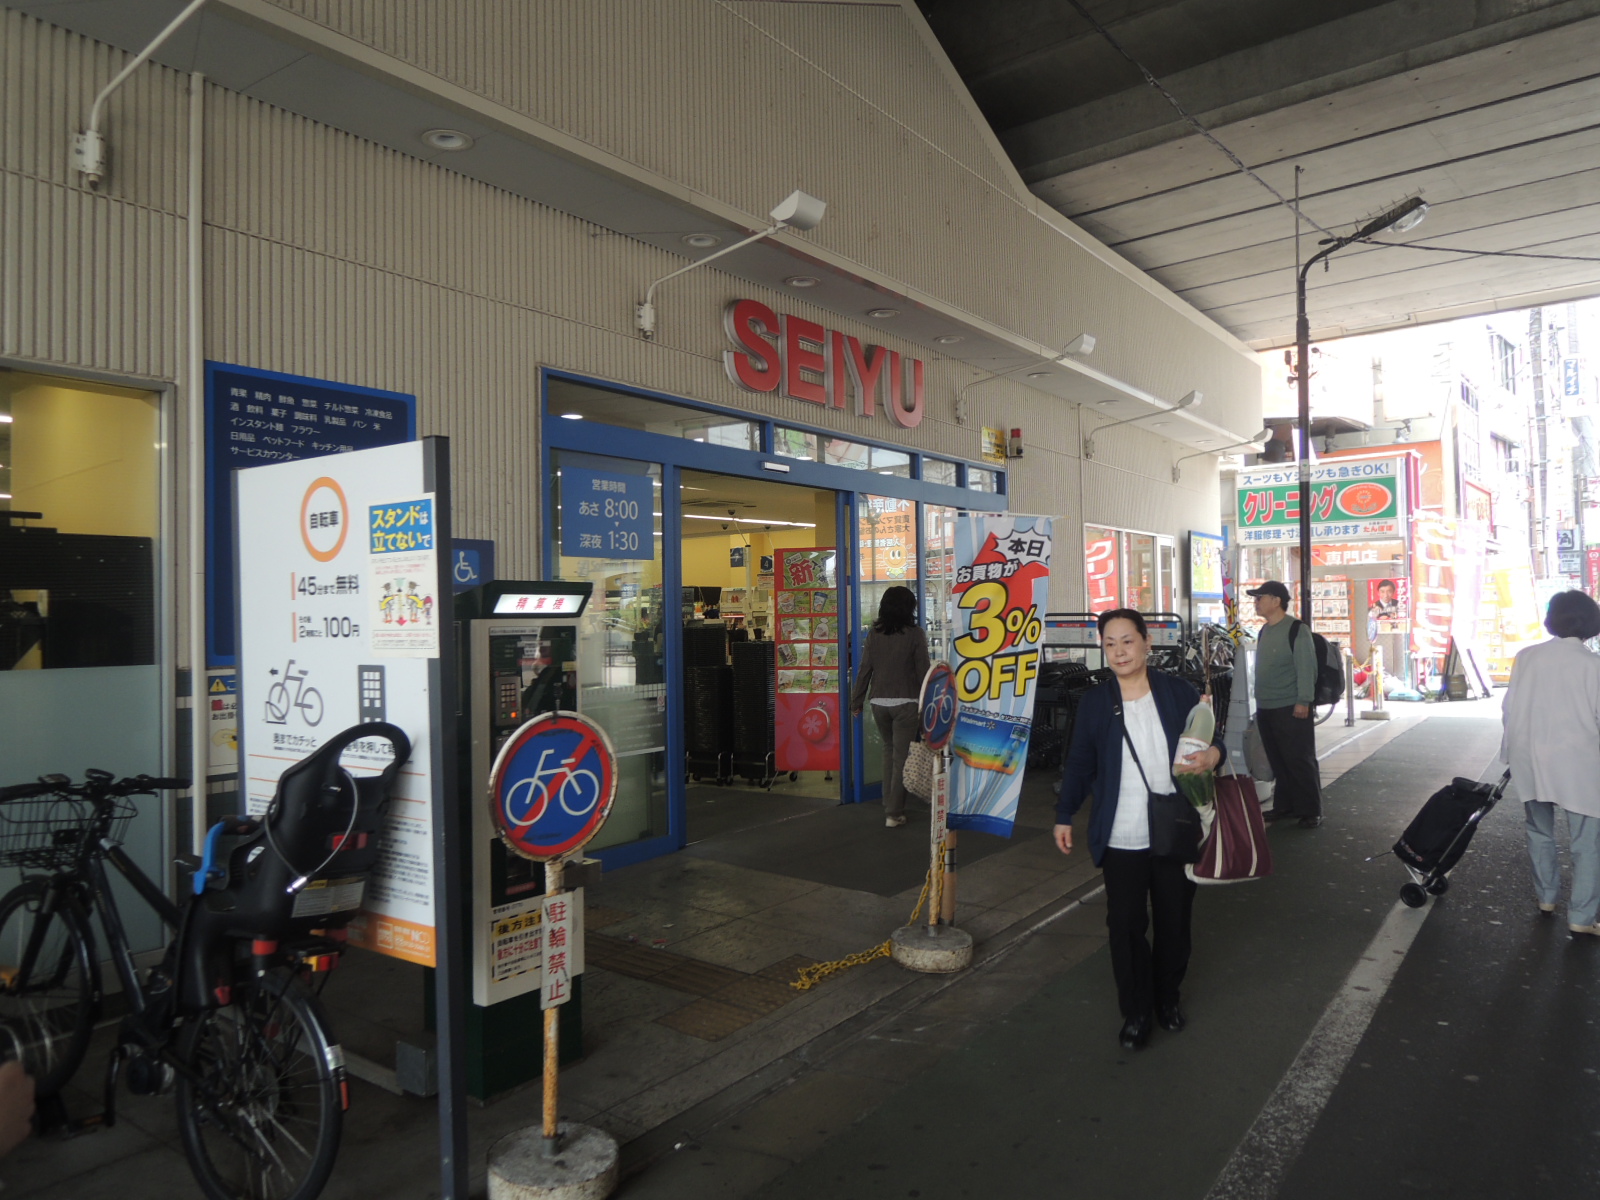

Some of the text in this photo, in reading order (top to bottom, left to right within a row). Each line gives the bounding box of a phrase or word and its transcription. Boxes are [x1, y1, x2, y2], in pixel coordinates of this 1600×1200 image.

[723, 299, 924, 428] SEIYU
[230, 401, 382, 431] 酒 飲料 菓子 調味料 乳製品 パン 米
[255, 391, 272, 402] 精肉
[279, 394, 295, 405] 鮮魚
[302, 398, 318, 408] 惣菜
[324, 402, 359, 414] チルド惣菜
[365, 408, 393, 420] 冷凍食品
[230, 416, 321, 435] インスタント麺 フラワー
[230, 431, 256, 443] 日用品
[230, 445, 301, 460] サービスカウンター
[1243, 463, 1390, 485] スーツもYシツも急ぎOK!
[592, 479, 626, 493] 営業時間
[372, 505, 429, 528] スタンドは
[579, 498, 639, 520] あさ 8:00
[310, 511, 339, 529] 自転車
[372, 531, 431, 552] 立てないで
[579, 530, 639, 551] 深夜 1:30
[1008, 537, 1045, 559] 本日
[1326, 549, 1378, 565] 専門店
[957, 561, 1020, 585] お買物が
[297, 575, 360, 596] 45分まで無料
[953, 581, 1042, 659] 3%
[955, 650, 1039, 703] OFF
[961, 716, 987, 728] Walmart
[497, 928, 543, 947] 自転車を引き出す
[548, 901, 567, 1002] 駐輪禁止
